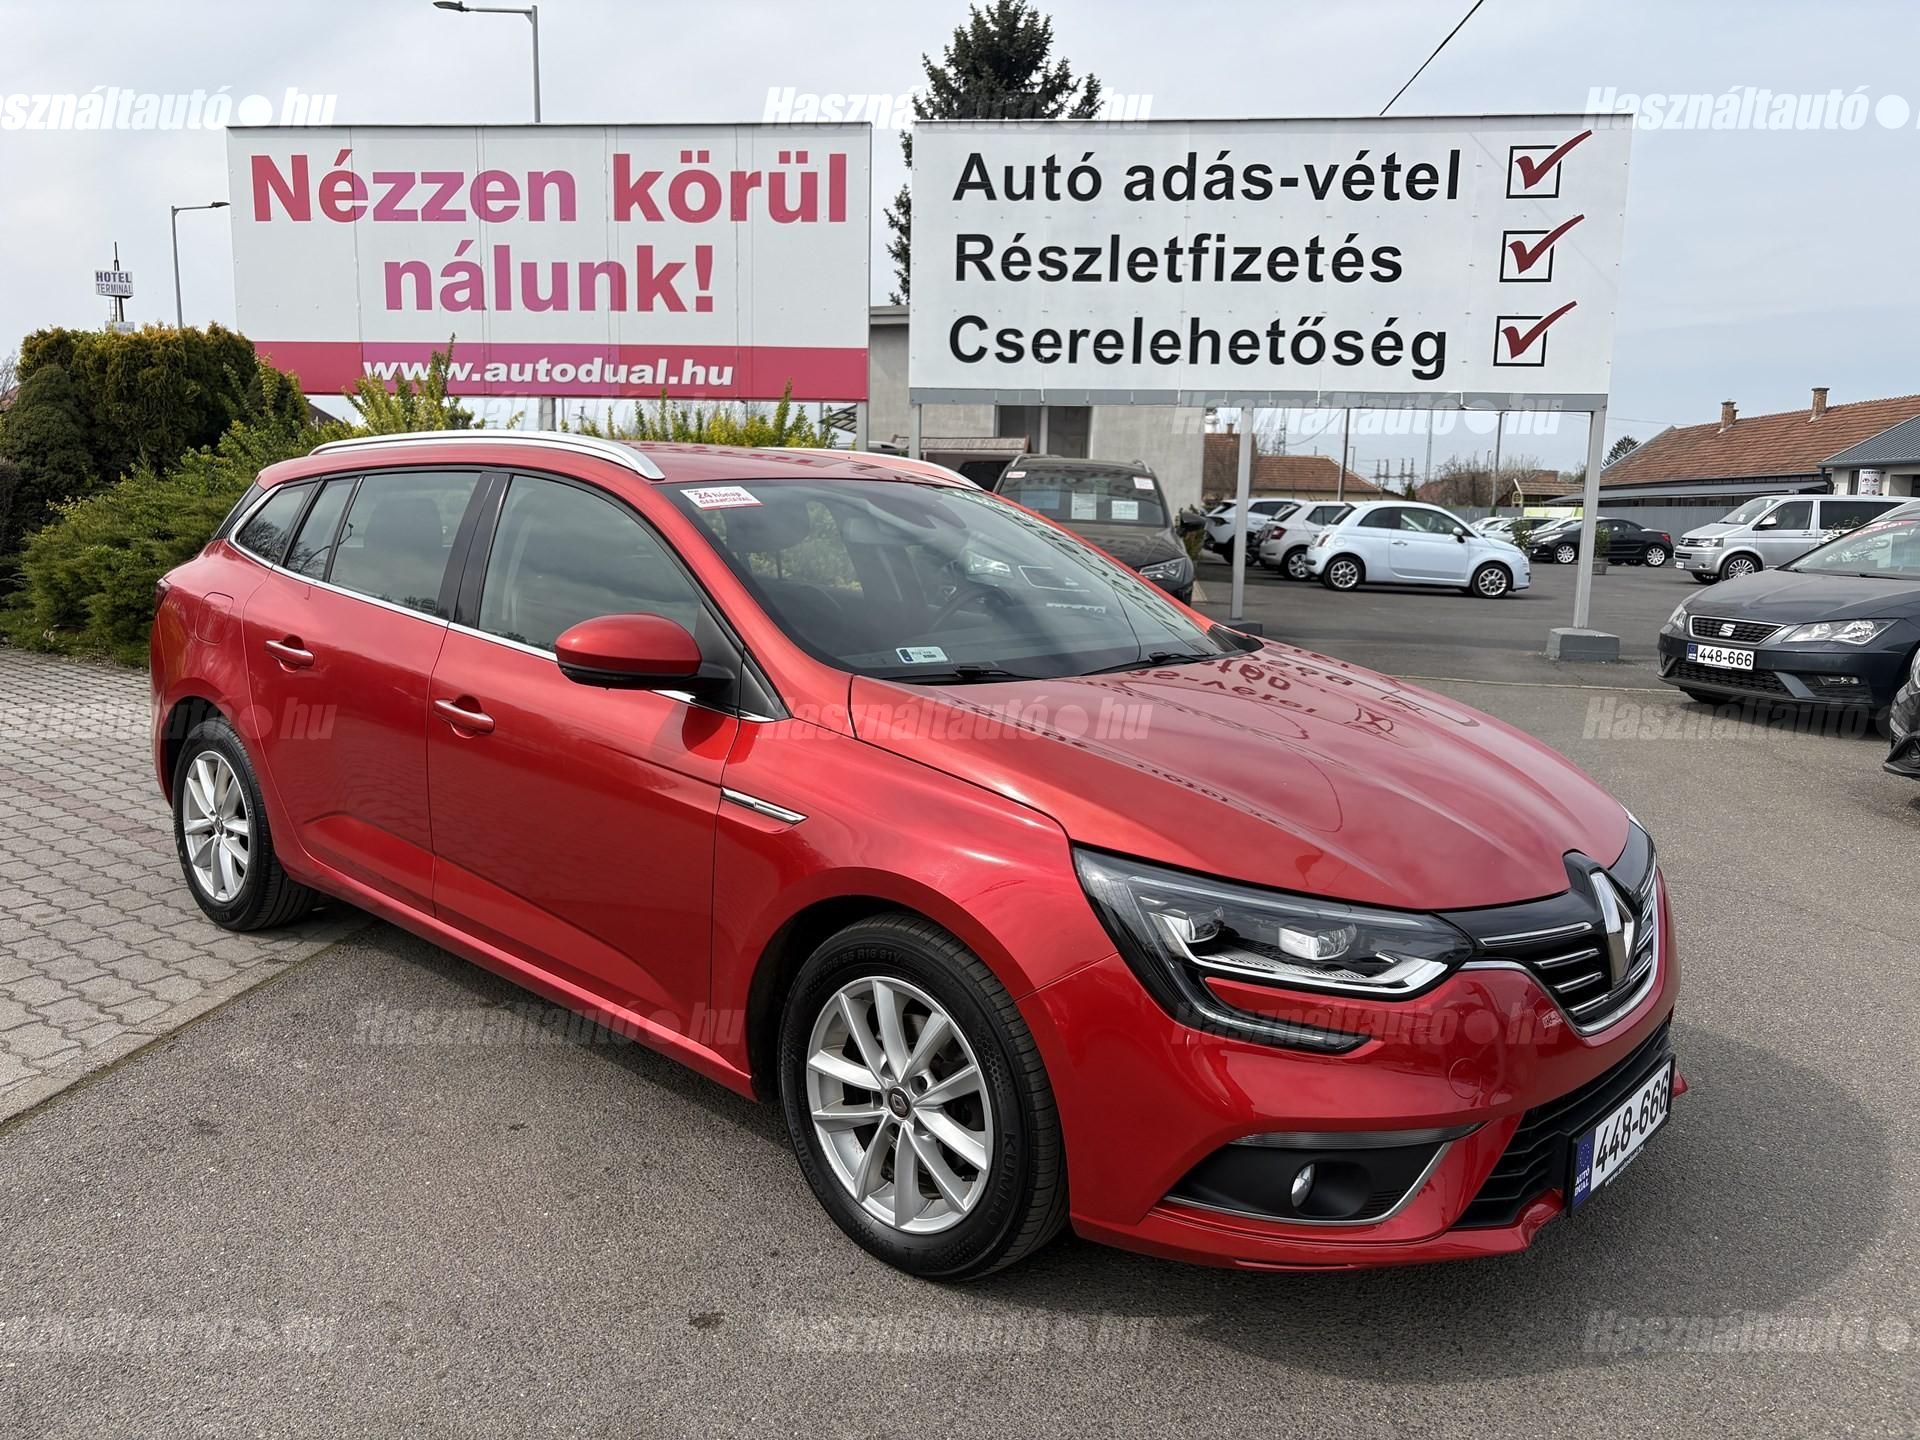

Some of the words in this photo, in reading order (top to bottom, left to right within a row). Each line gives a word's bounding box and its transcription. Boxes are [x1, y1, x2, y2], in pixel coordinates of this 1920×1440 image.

[251, 149, 576, 223] Nézzen
[613, 150, 847, 224] körül
[953, 151, 1102, 202] Autó
[1124, 149, 1460, 202] adás-vétel
[96, 271, 132, 283] HOTEL
[385, 240, 713, 313] nálunk!
[955, 232, 1402, 283] Részletfizetés
[96, 283, 133, 295] TERMINAL
[363, 357, 733, 386] www.autodual.hu
[949, 315, 1446, 381] Cserelehetőség
[1699, 647, 1753, 667] 448-666
[1595, 1069, 1669, 1174] 448-666
